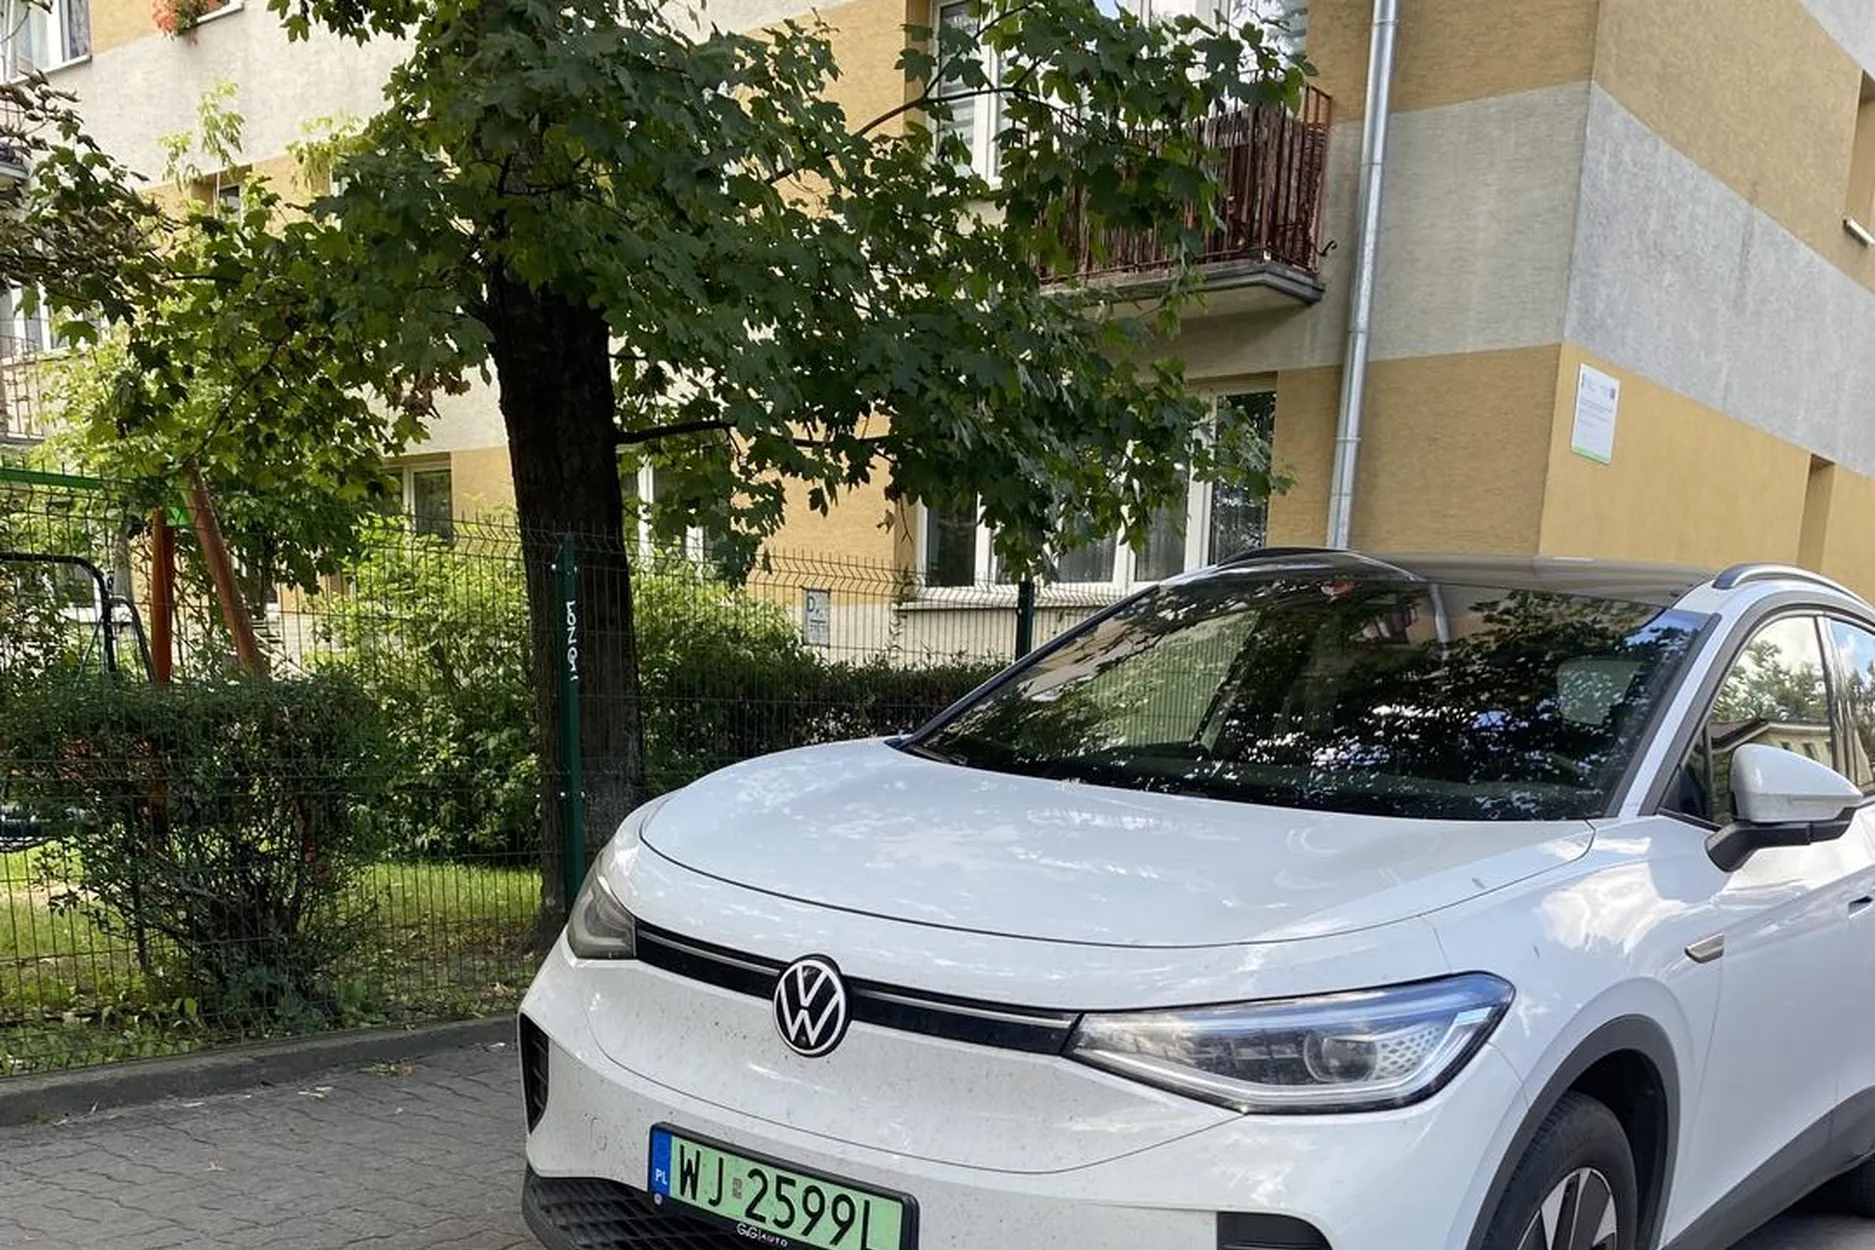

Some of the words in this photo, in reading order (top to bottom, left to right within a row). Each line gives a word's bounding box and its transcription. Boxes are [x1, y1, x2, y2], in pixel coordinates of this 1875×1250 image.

[777, 961, 842, 1048] VW
[655, 1168, 668, 1185] PL
[680, 1144, 724, 1207] WJ
